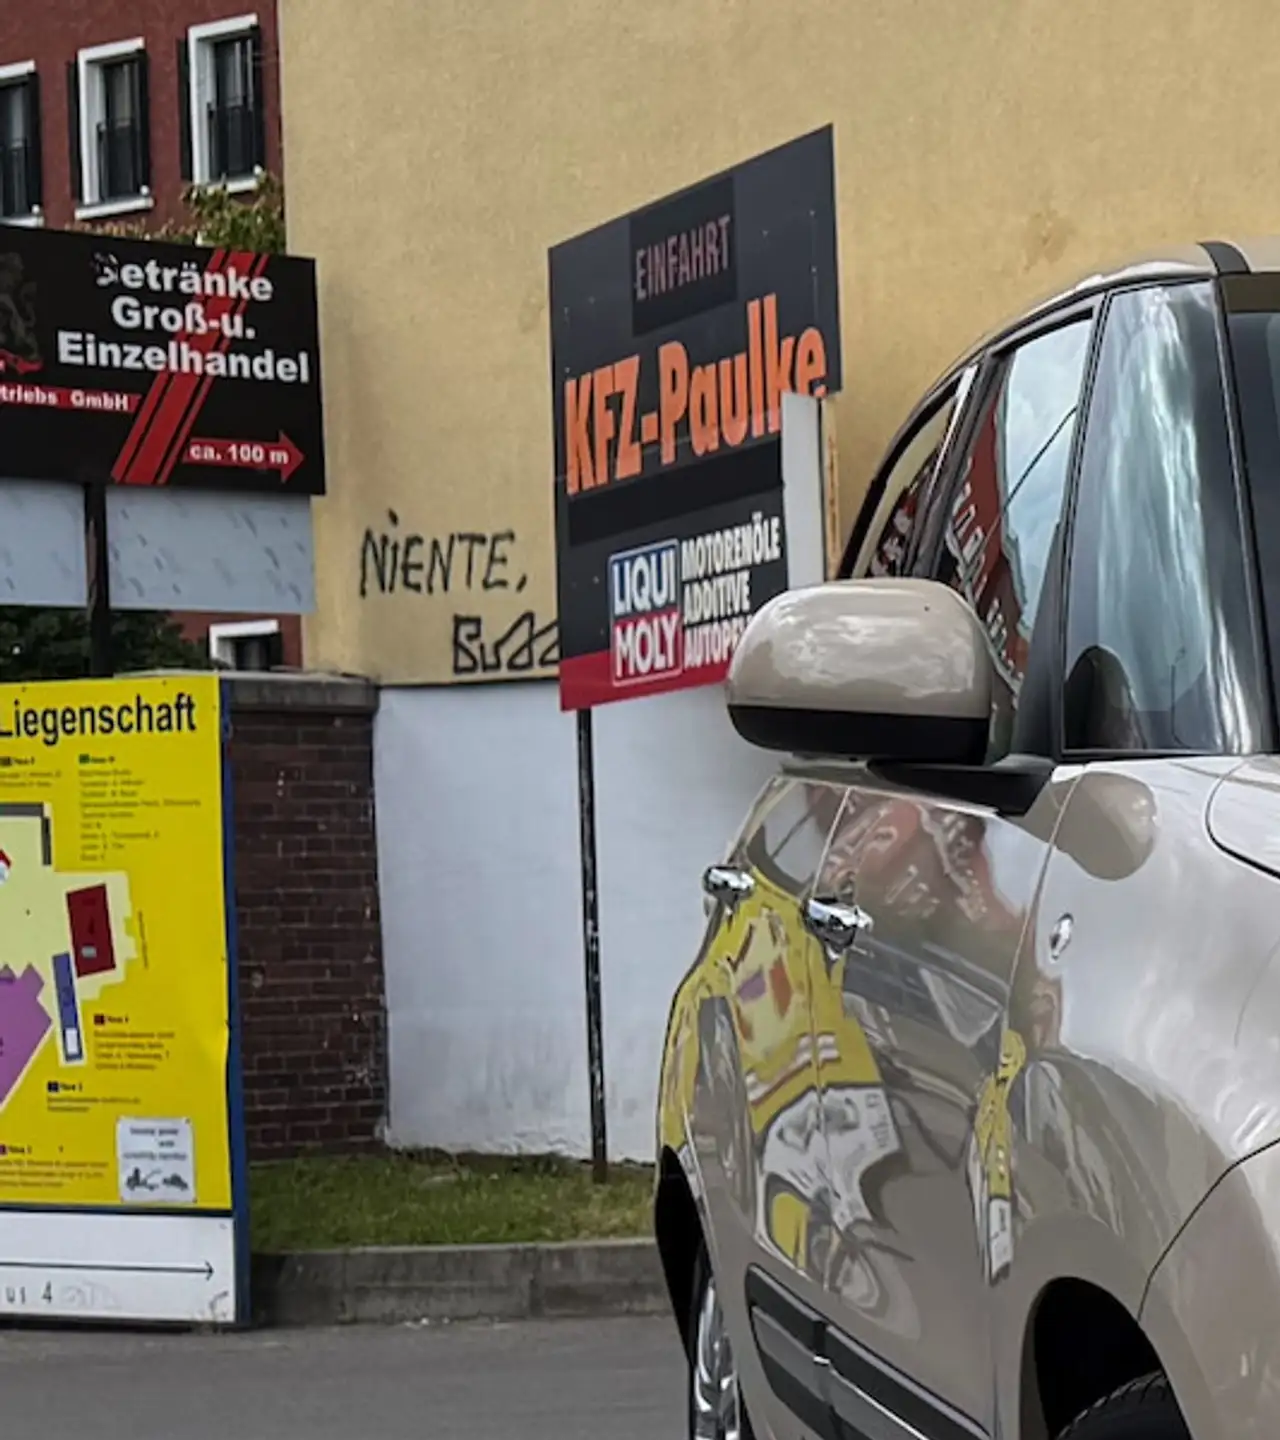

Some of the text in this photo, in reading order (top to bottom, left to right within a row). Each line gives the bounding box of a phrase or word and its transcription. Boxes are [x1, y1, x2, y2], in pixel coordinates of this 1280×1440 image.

[636, 213, 731, 301] EINFAHRT
[57, 330, 310, 383] Einzelhandel
[71, 389, 129, 411] GmbH
[565, 293, 827, 495] KFZ-Paulke
[190, 444, 289, 464] ca. 100 m
[681, 511, 781, 582] MOTORENÖLE
[612, 549, 676, 617] LIQUI
[684, 570, 750, 625] ADDITIVE
[615, 611, 679, 680] MOLY
[0, 692, 197, 746] iegenschaft
